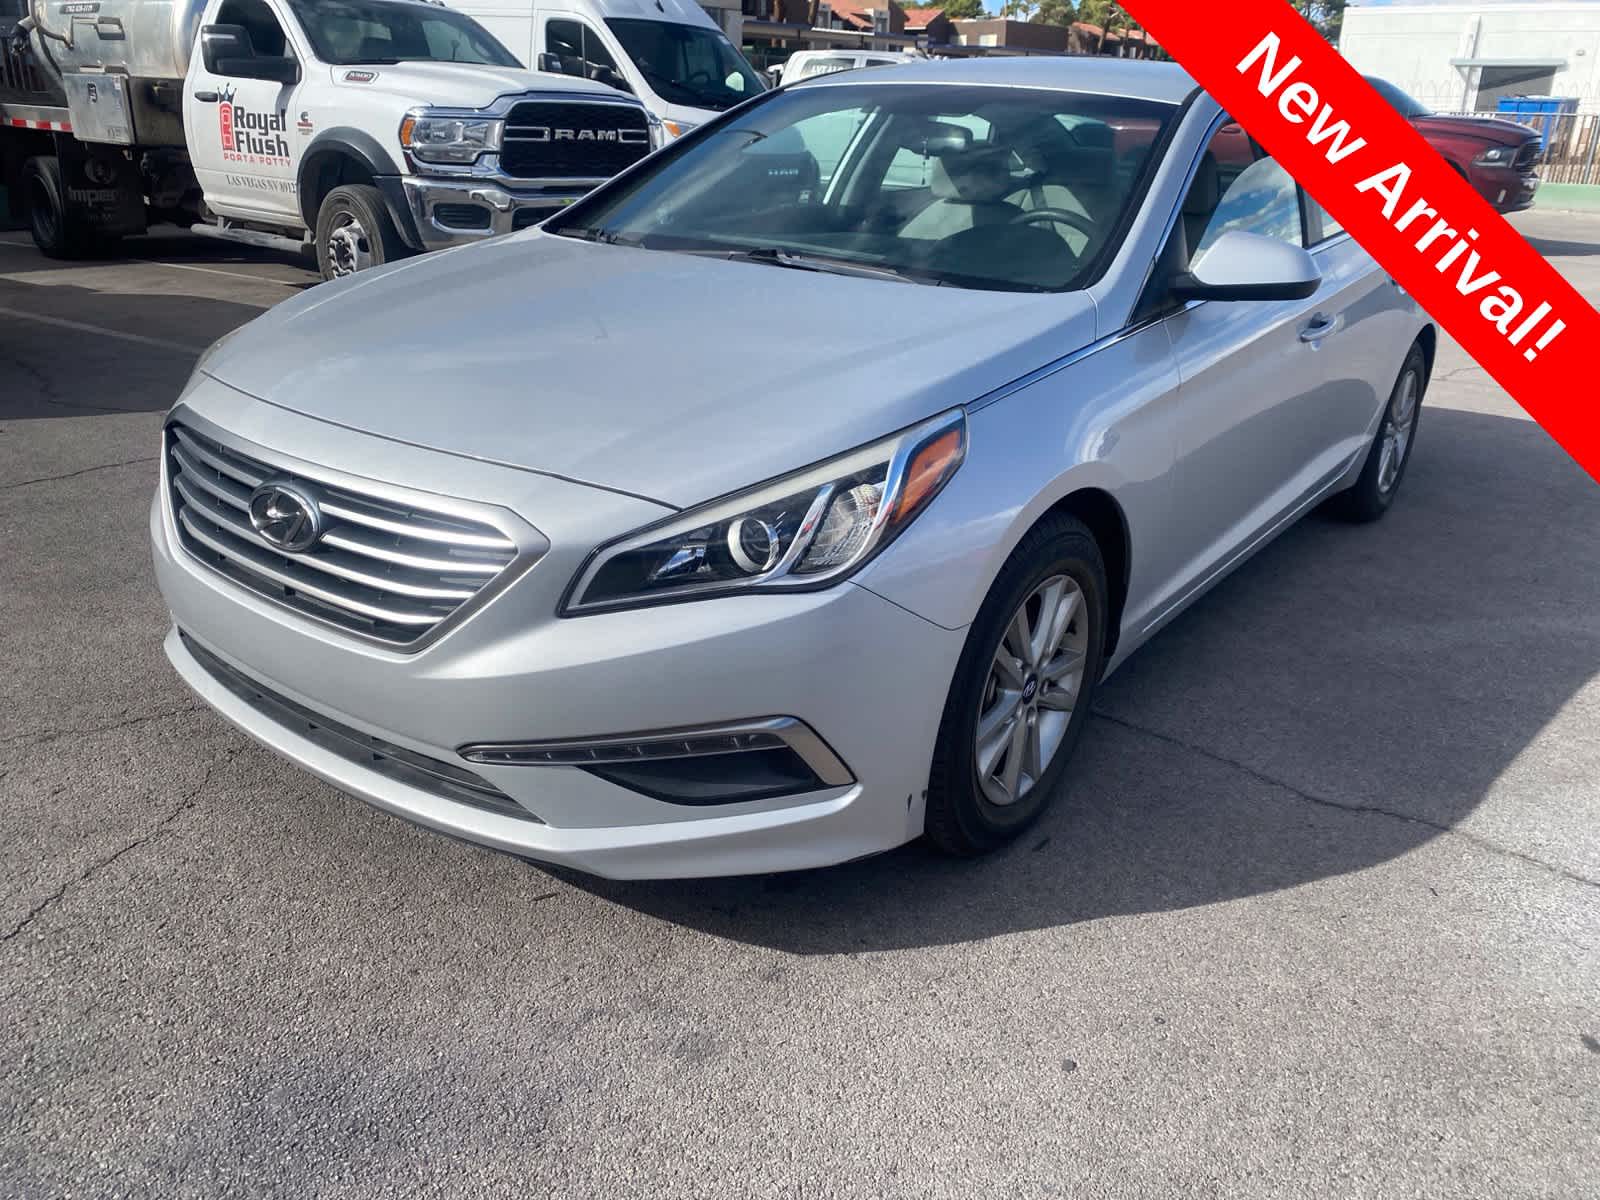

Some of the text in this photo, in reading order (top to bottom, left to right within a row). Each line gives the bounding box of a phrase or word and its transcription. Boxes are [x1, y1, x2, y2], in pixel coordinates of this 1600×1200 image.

[233, 106, 287, 136] Royal
[554, 128, 617, 140] RAM
[235, 131, 290, 157] Flush
[223, 152, 292, 167] PORTA POTTY
[225, 174, 241, 186] LAS
[240, 175, 267, 190] VEGAS
